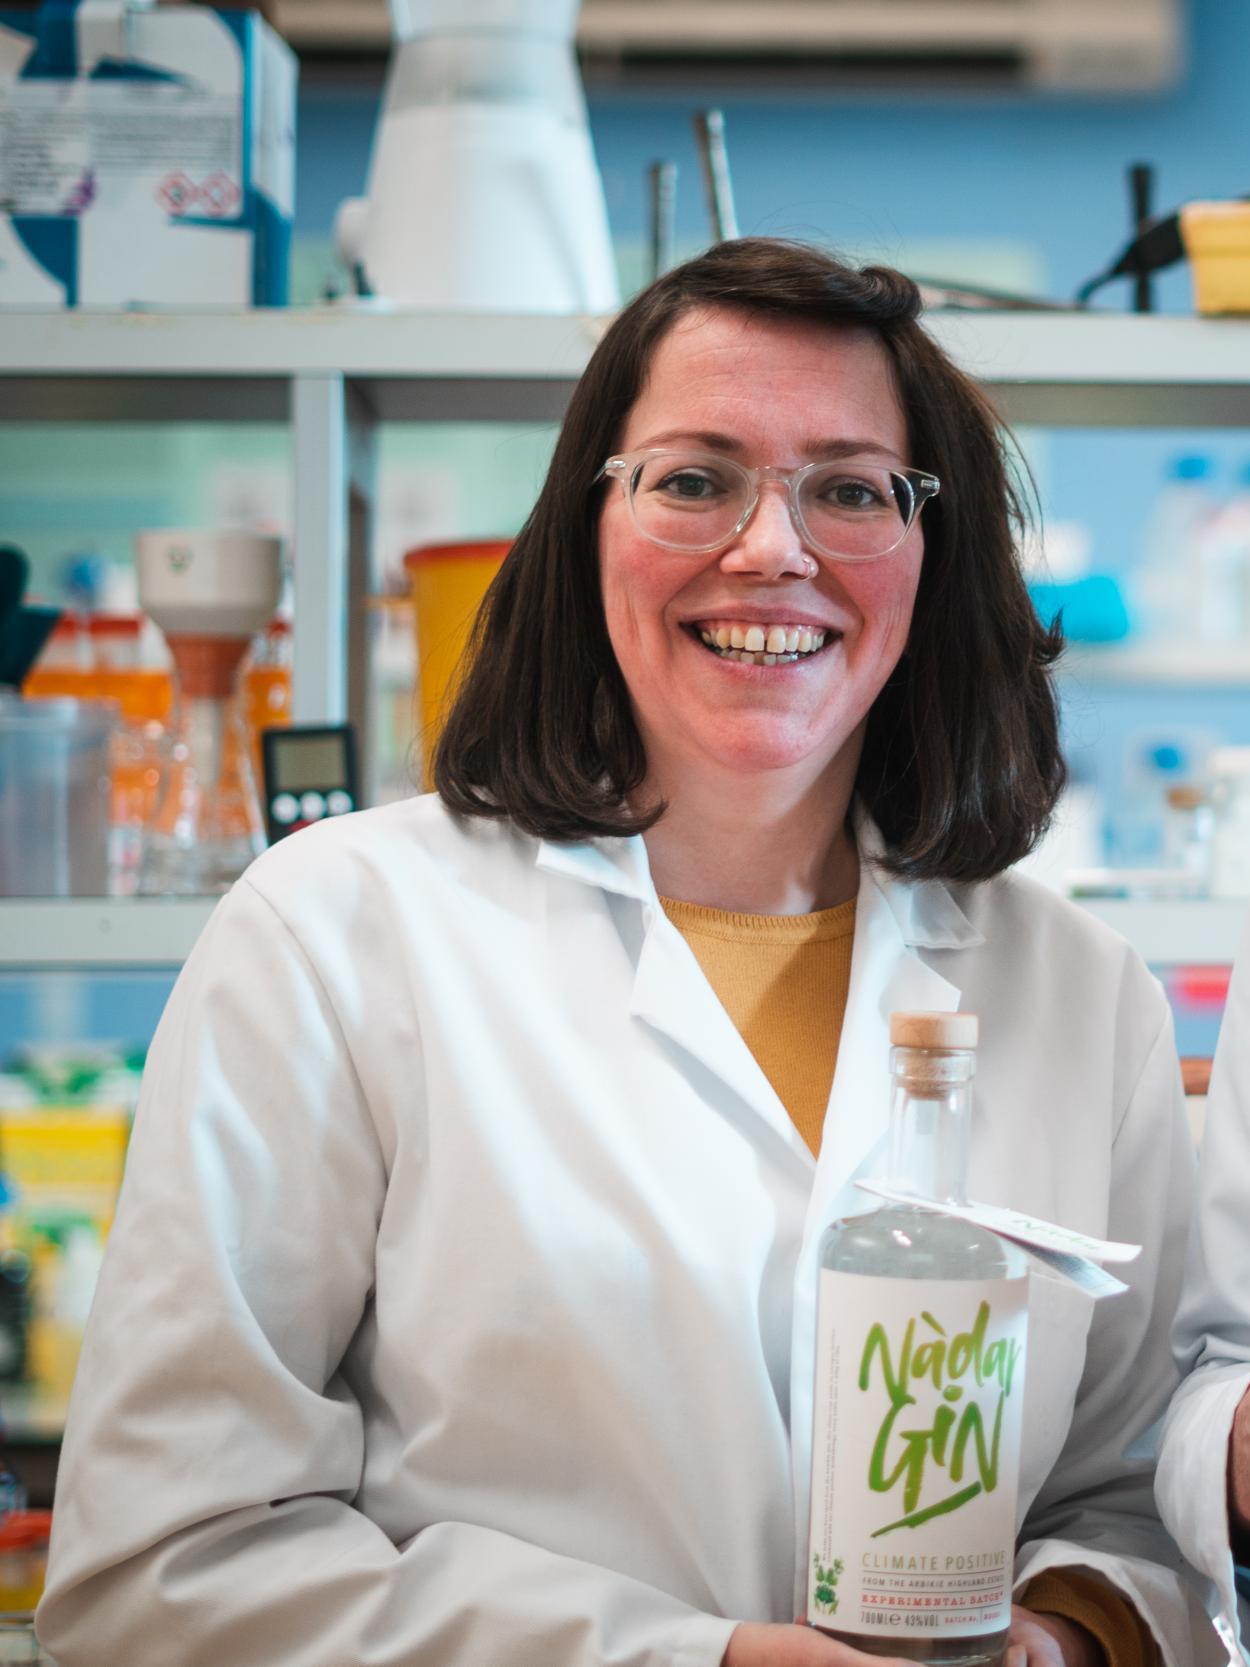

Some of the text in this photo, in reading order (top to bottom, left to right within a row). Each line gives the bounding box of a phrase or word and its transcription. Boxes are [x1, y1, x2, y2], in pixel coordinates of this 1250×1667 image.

[862, 1550, 1006, 1570] CLIMATE POSITIVE
[862, 1576, 885, 1586] FROM
[889, 1578, 905, 1588] THE
[947, 1576, 985, 1588] HIGHLAND
[862, 1594, 966, 1607] EXPERIMENTAL
